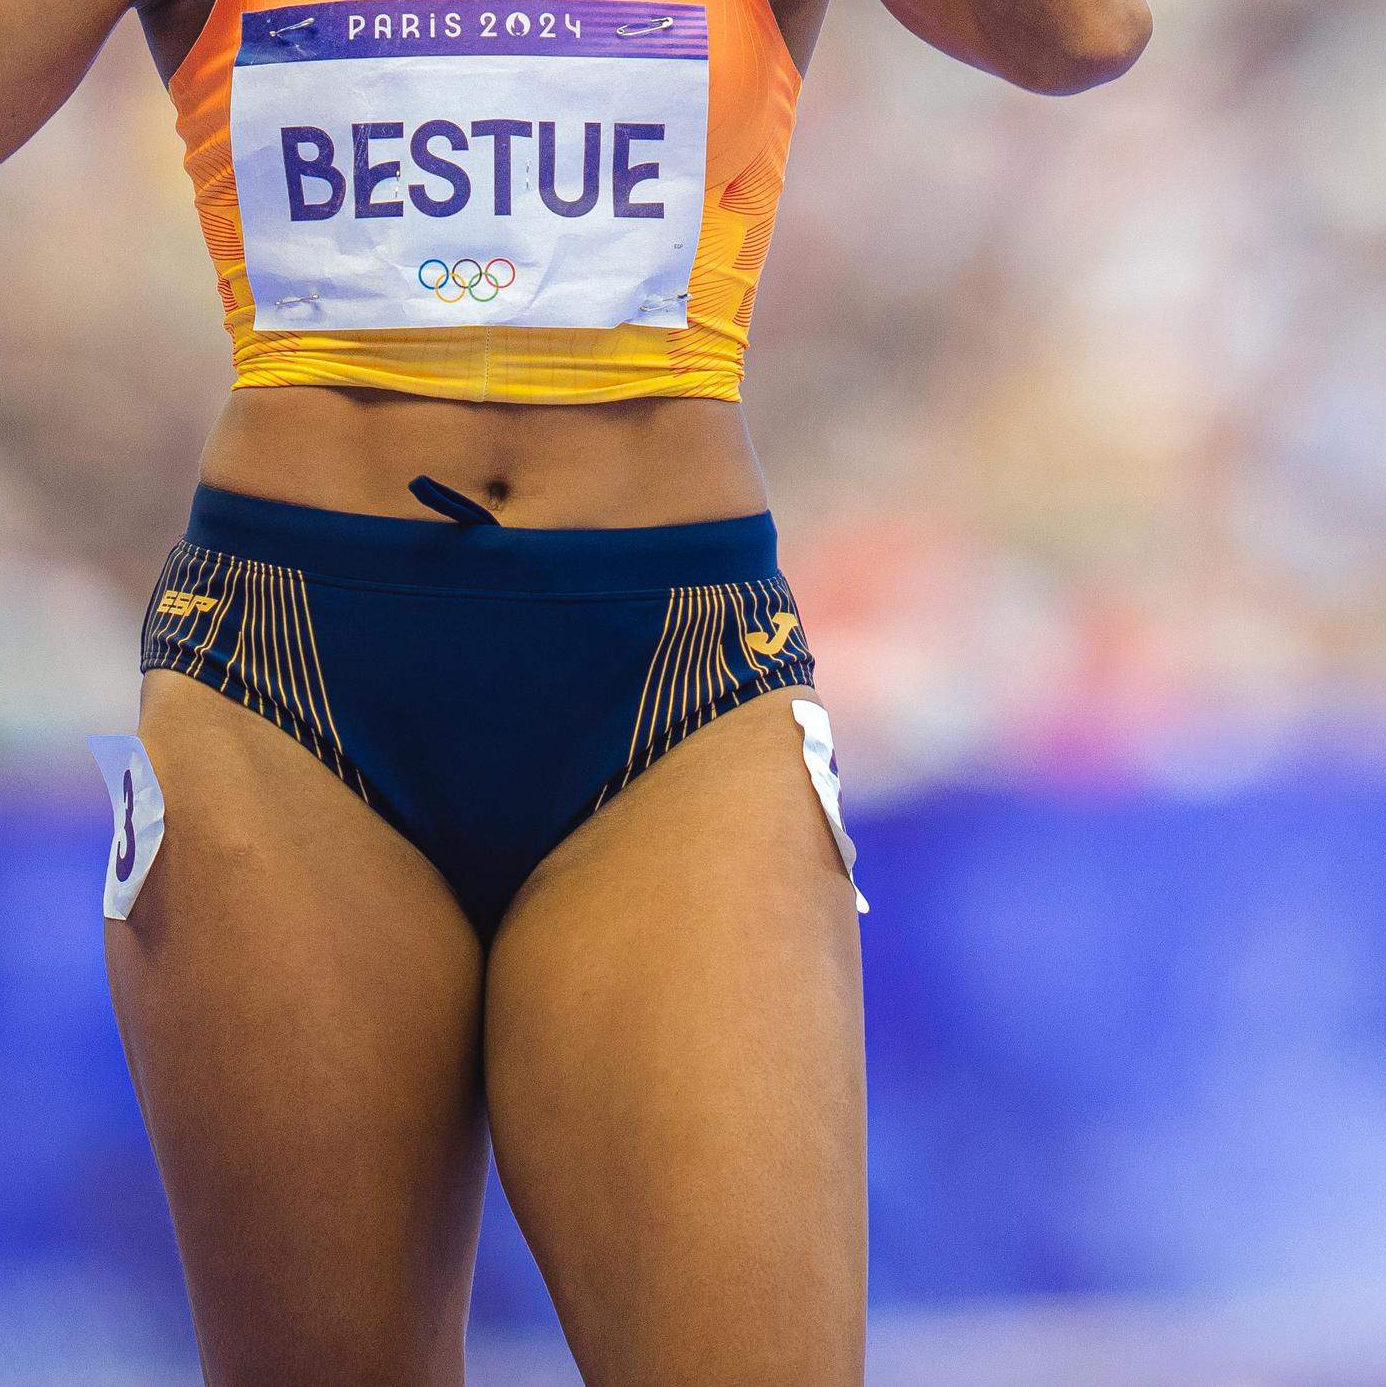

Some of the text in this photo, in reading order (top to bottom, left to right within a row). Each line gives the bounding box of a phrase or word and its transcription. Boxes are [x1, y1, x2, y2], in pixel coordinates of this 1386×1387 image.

[348, 12, 581, 39] PARIS 2024
[280, 119, 664, 222] BESTUE
[157, 590, 218, 617] ESP
